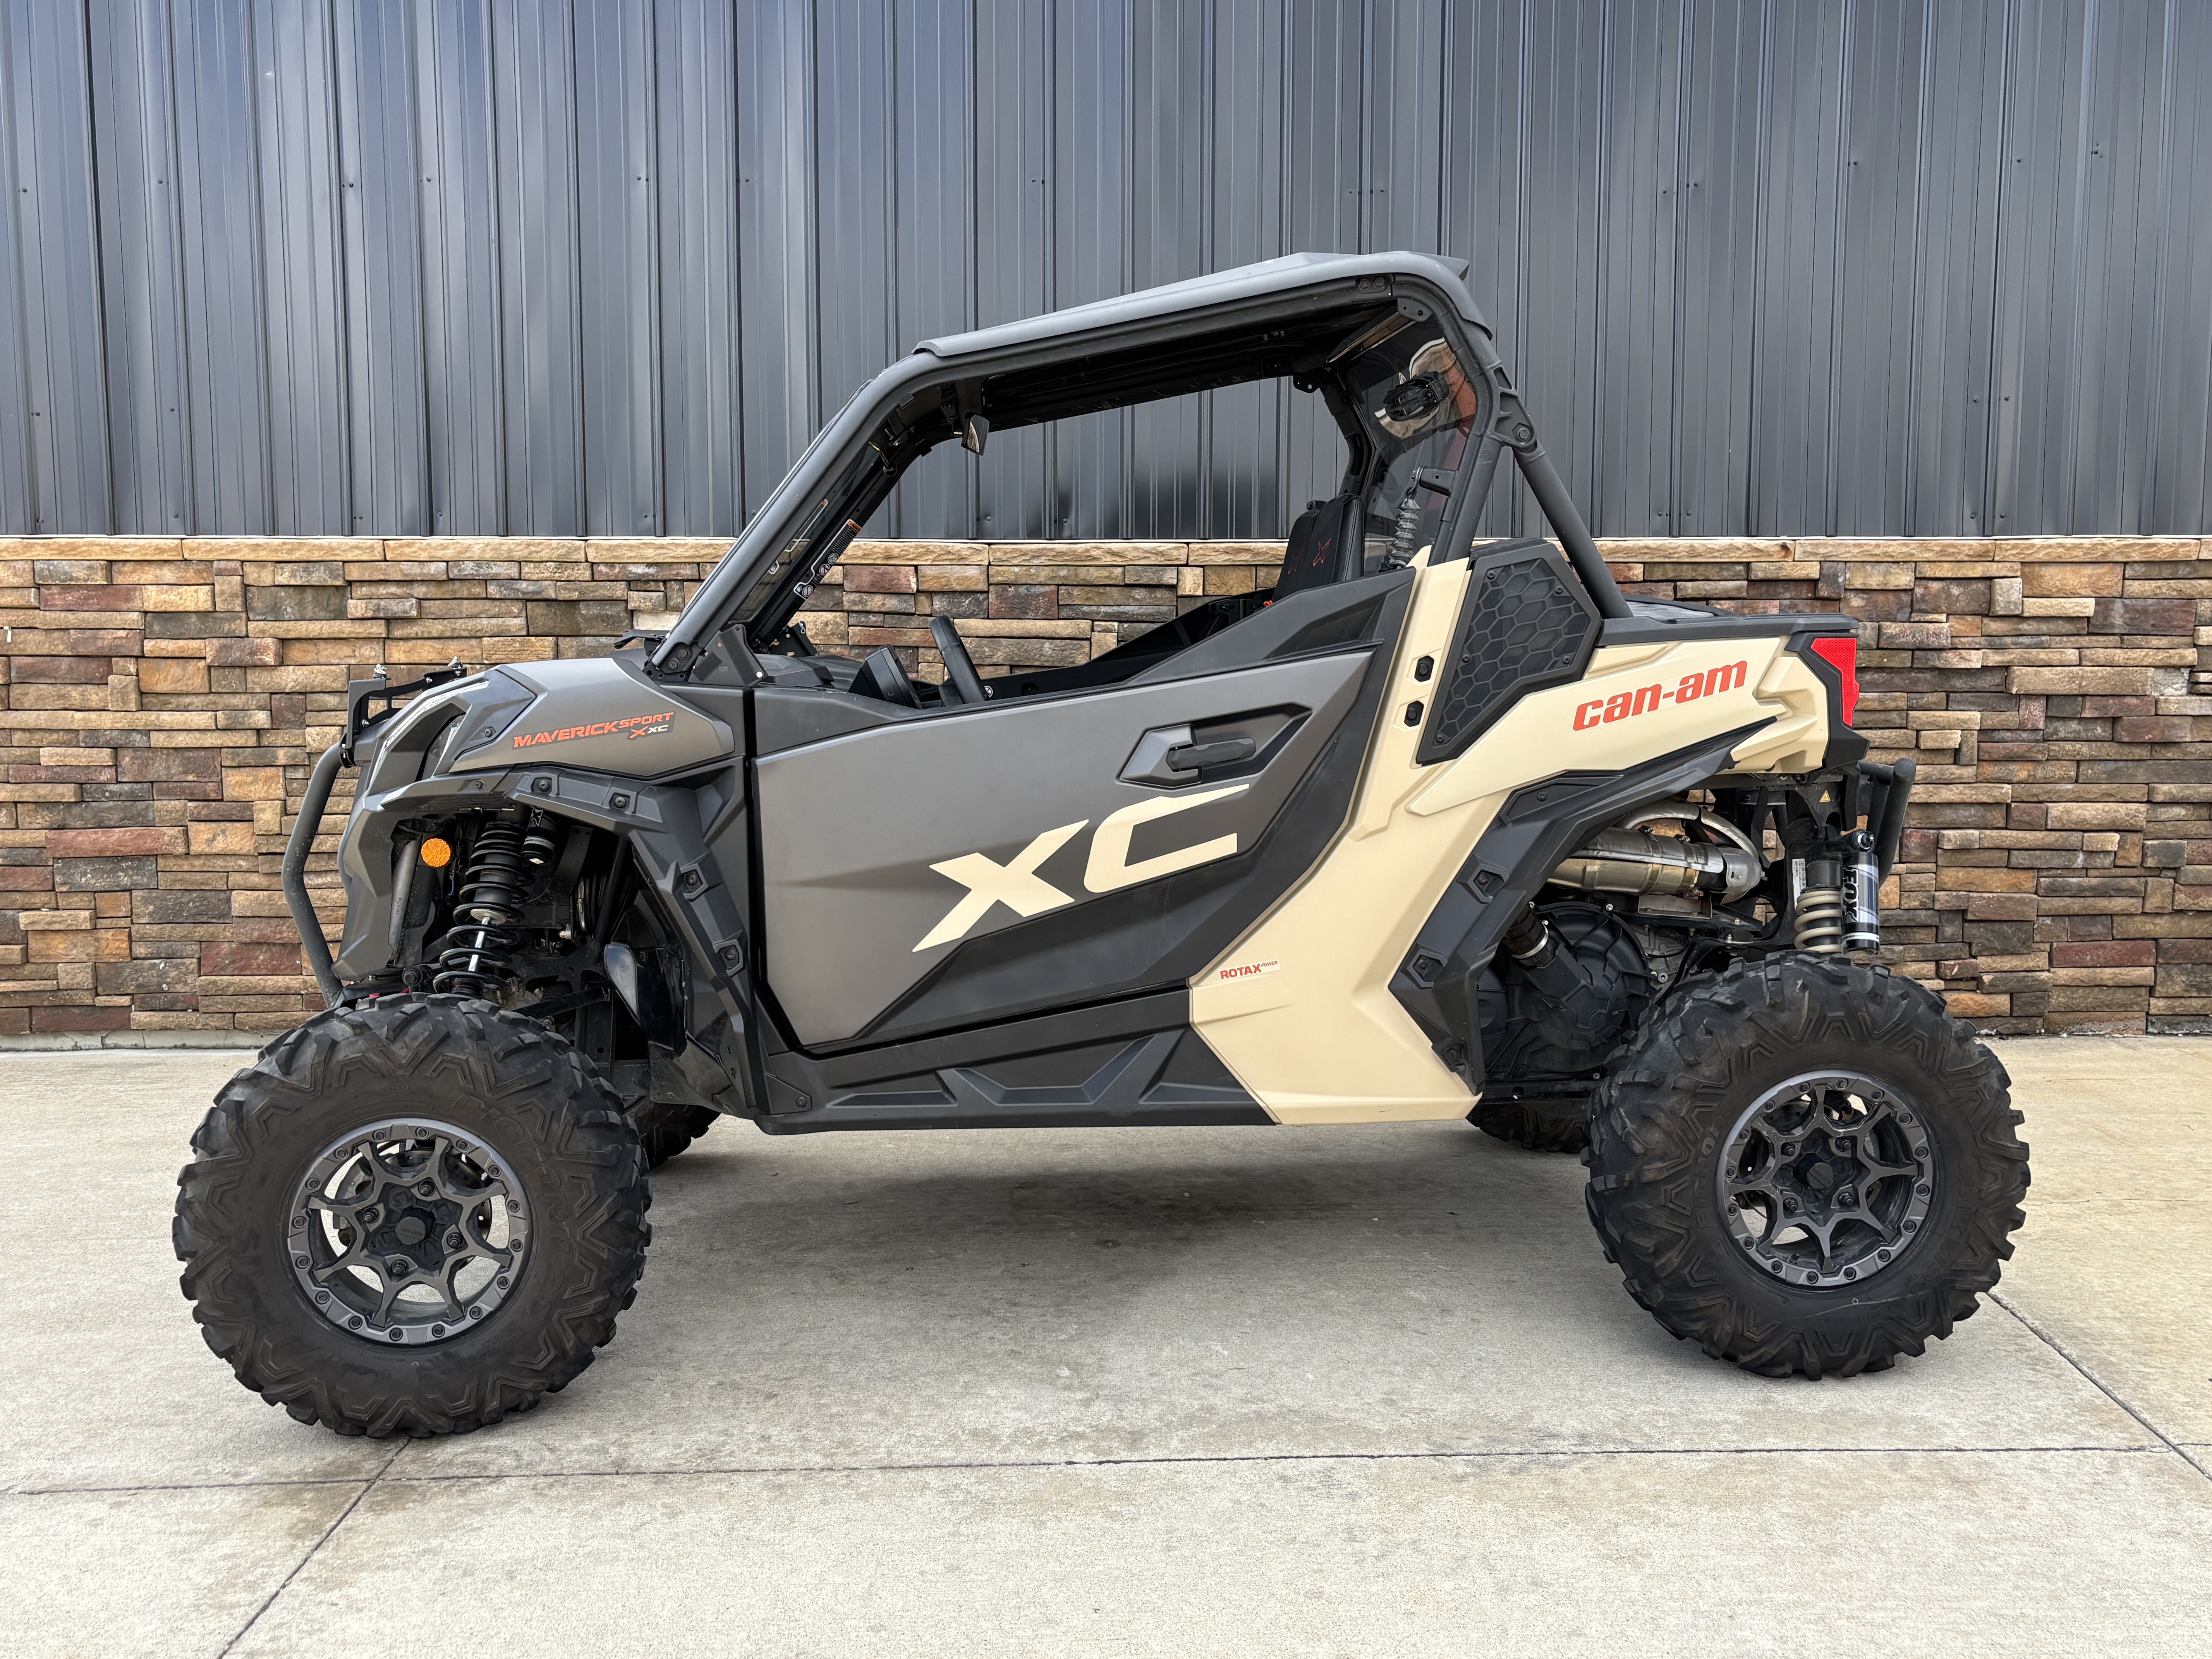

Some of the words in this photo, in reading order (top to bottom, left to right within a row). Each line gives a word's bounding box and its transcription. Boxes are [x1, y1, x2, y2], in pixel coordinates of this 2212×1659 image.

[1572, 660, 1747, 731] can-am
[514, 720, 619, 748] MAVERICK
[618, 712, 674, 728] SPORT
[912, 783, 1250, 953] XC
[1841, 867, 1859, 924] FOX
[1220, 964, 1262, 979] ROTAX
[450, 1092, 571, 1253] BIGHORN
